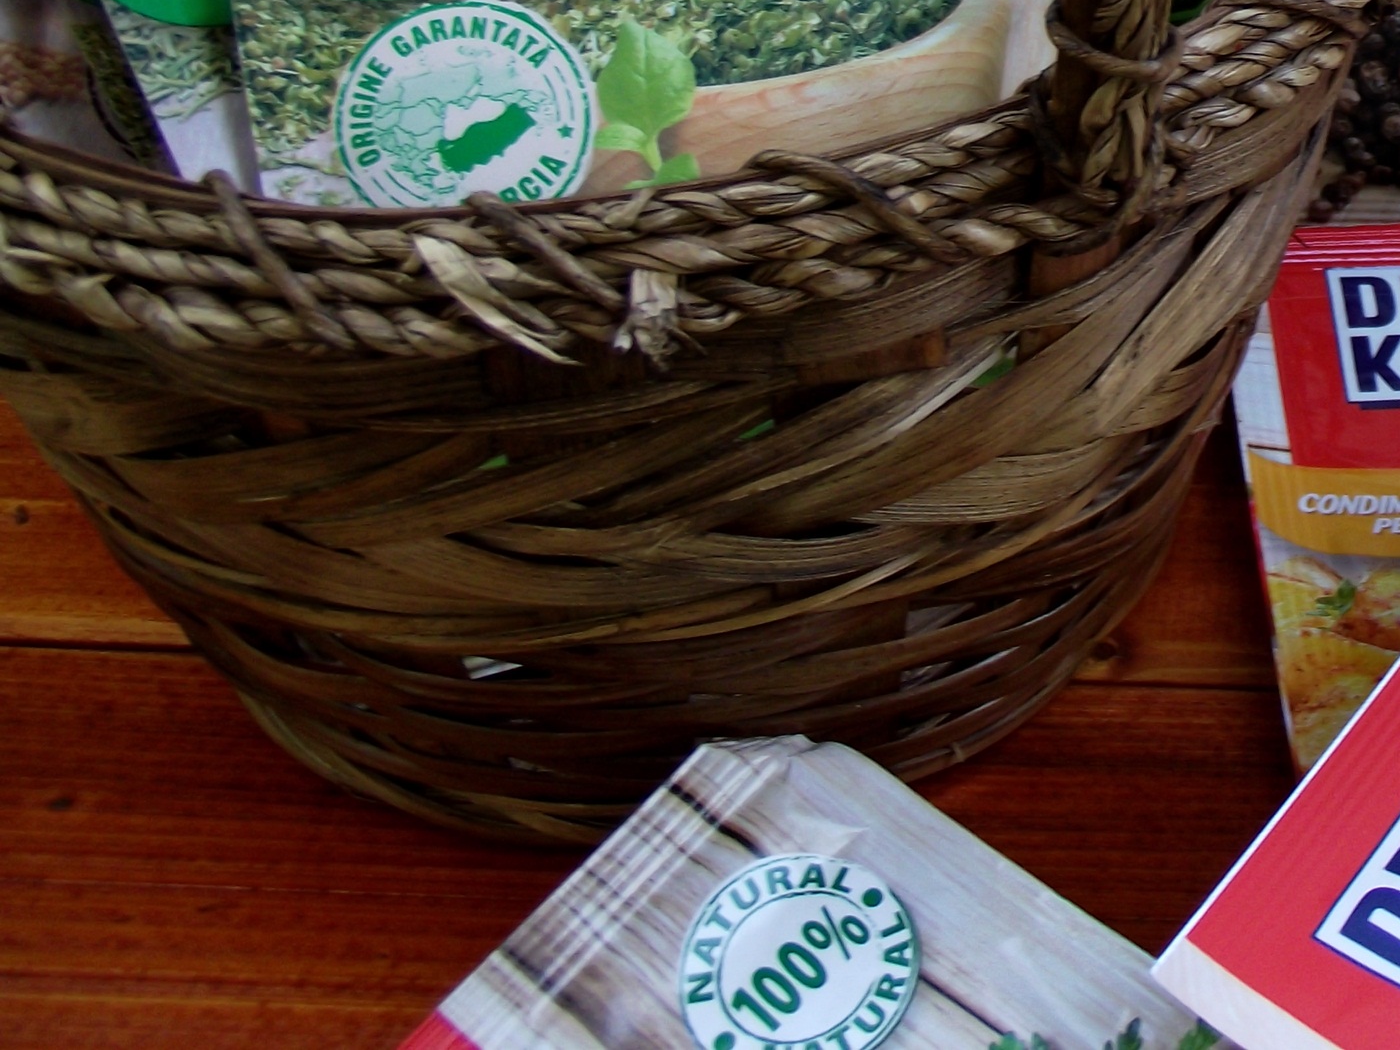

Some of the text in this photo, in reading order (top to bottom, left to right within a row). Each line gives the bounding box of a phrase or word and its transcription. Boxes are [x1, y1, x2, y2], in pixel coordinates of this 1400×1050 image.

[349, 56, 394, 168] ORIGINE
[498, 154, 568, 204] RCIA
[687, 862, 853, 1005] NATURAL
[731, 904, 871, 1033] 100%
